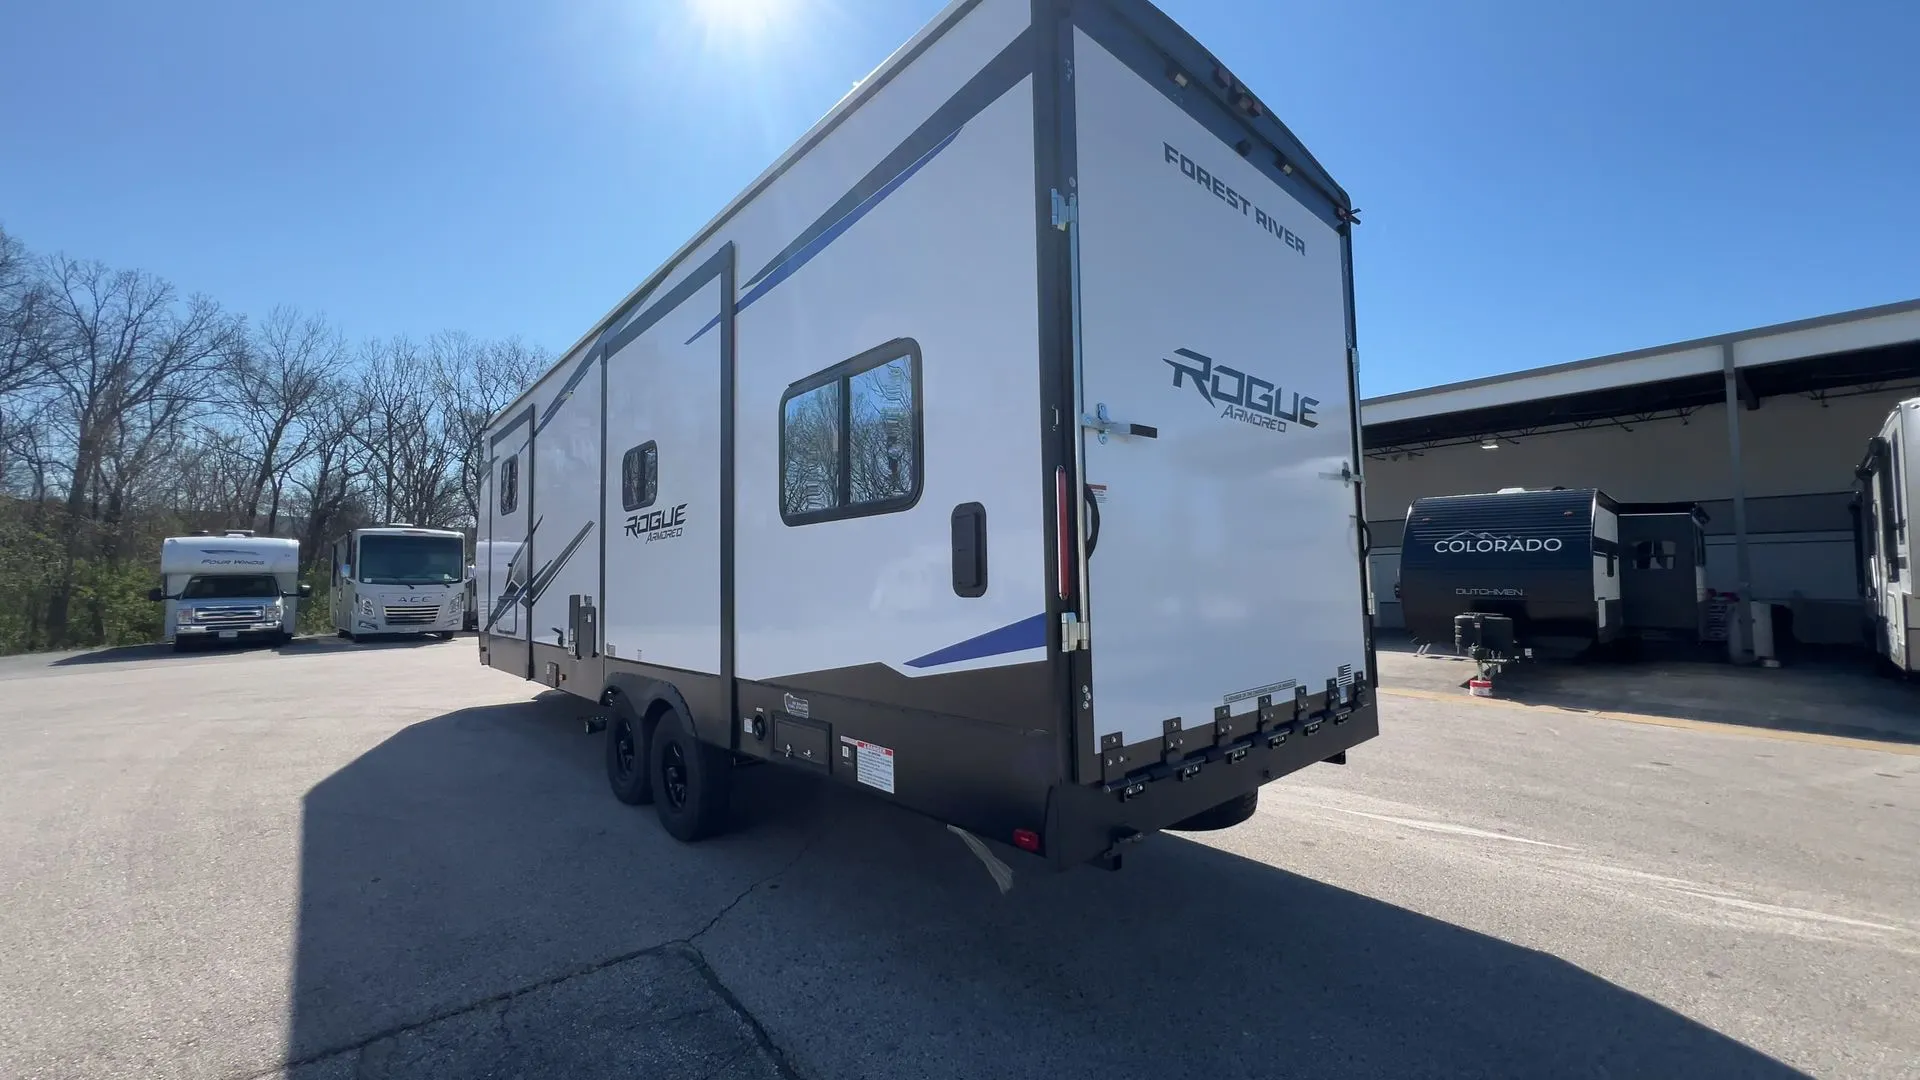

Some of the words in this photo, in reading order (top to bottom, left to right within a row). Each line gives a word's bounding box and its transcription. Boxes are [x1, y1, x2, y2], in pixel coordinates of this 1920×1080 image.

[1163, 141, 1251, 217] FOREST
[1254, 206, 1306, 257] RIVER
[1162, 347, 1321, 429] ROGUE
[1221, 404, 1287, 433] ARMORED
[623, 502, 689, 540] ROGUE
[645, 527, 683, 545] ARMORED
[1434, 538, 1562, 553] COLORADO
[201, 558, 232, 566] FOUR
[1455, 588, 1523, 596] DUTCHMEN
